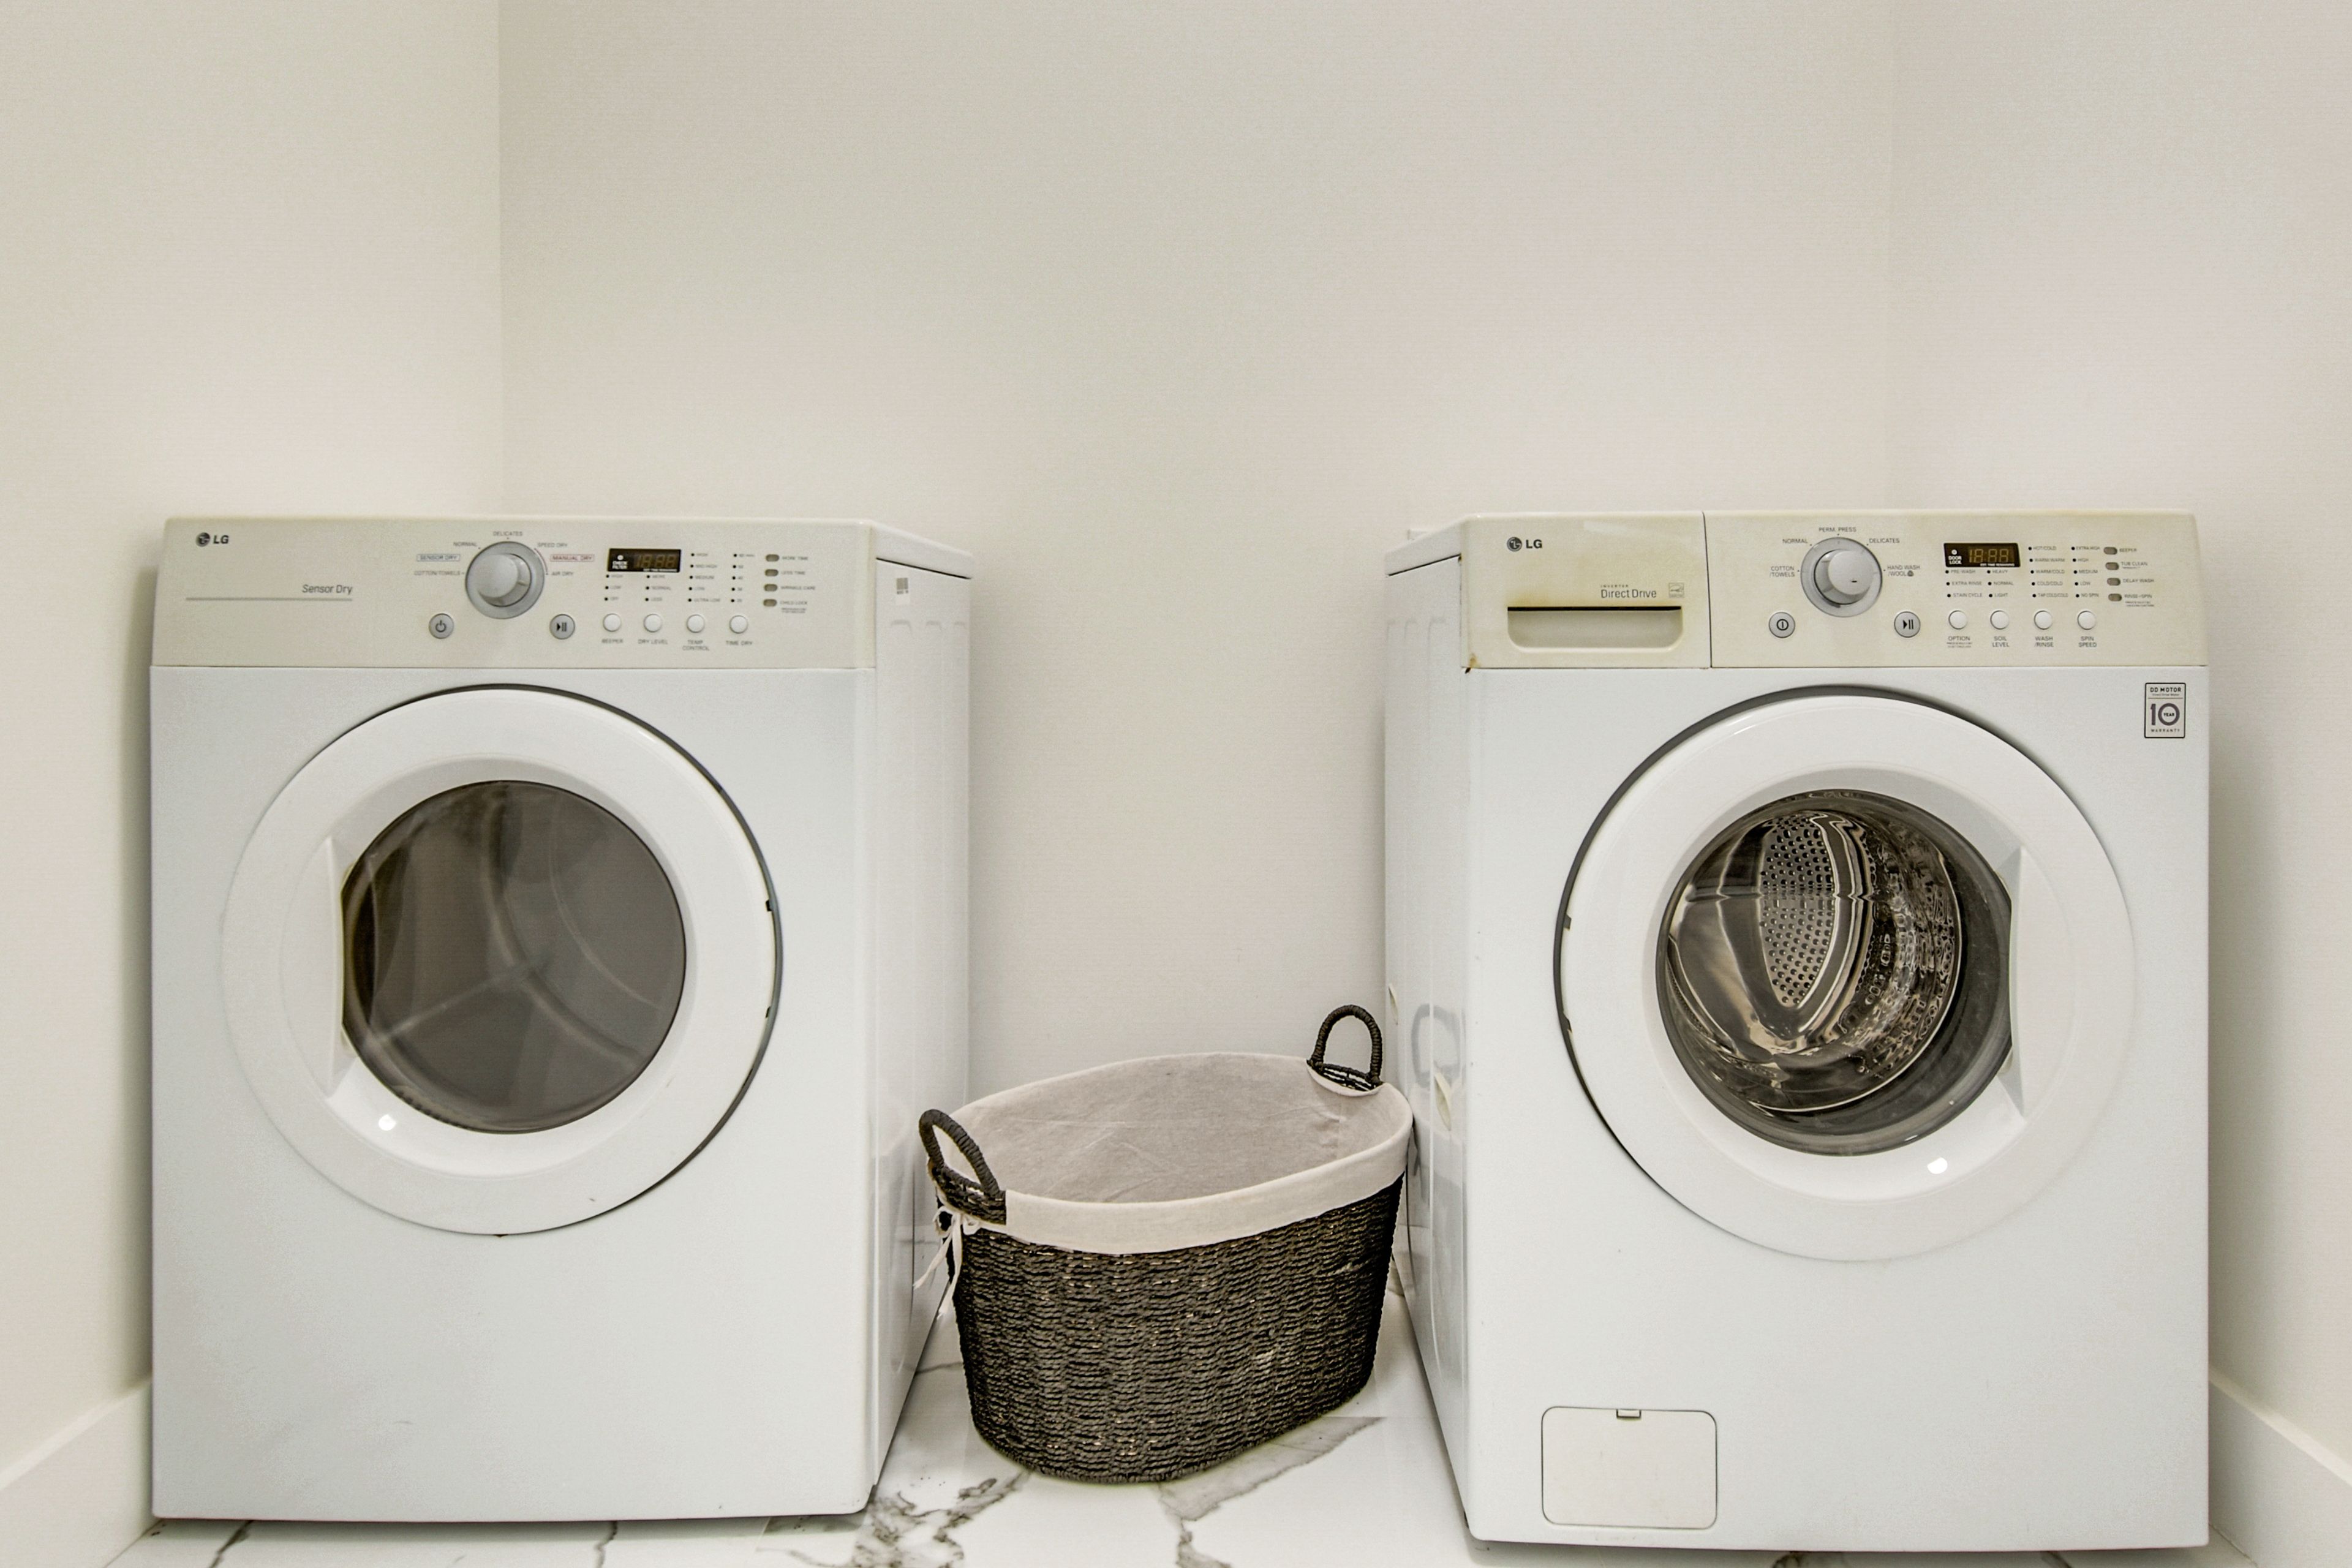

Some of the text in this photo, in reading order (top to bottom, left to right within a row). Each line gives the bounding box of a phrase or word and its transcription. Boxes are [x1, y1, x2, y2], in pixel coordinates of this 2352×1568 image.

[213, 535, 229, 544] LG
[1526, 539, 1543, 549] LG
[302, 584, 353, 595] Sensor Dry
[1600, 589, 1657, 598] Direct Drive
[2150, 703, 2180, 726] 10
